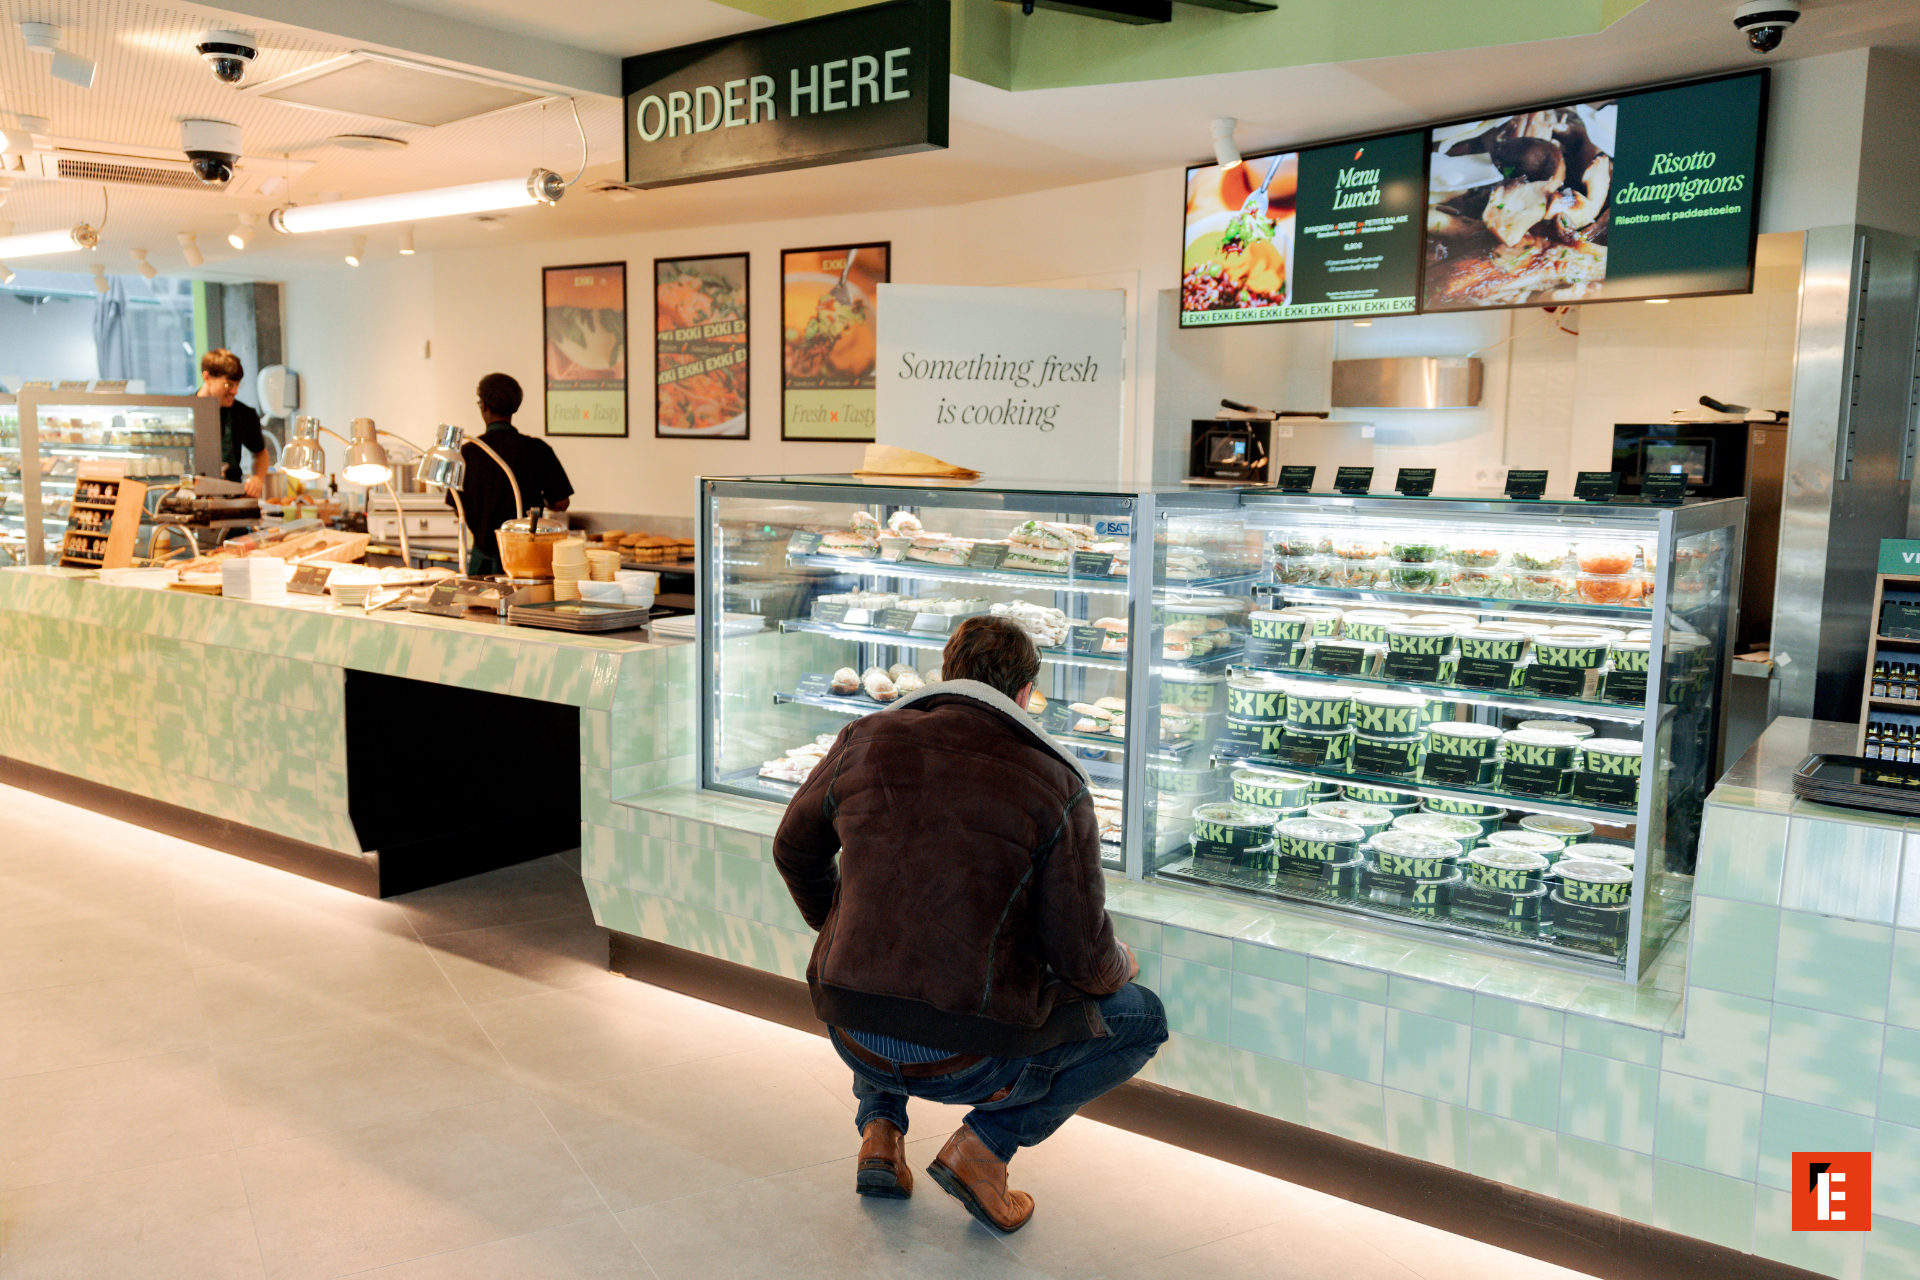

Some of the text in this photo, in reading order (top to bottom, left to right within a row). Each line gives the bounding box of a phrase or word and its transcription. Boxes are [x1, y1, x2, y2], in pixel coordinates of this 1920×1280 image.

[637, 47, 911, 142] ORDER HERE
[1649, 150, 1716, 176] Risotto
[1335, 166, 1380, 189] Menu
[1615, 175, 1745, 204] champignons
[1332, 184, 1381, 210] Lunch
[1615, 204, 1742, 226] Risotto met paddestoelen
[1189, 313, 1210, 323] EXKi
[1212, 311, 1233, 321] EXKi
[1235, 309, 1257, 320] EXKi
[1260, 307, 1282, 318] EXKi
[1284, 306, 1307, 316] EXKi
[1310, 305, 1334, 315] EXKi
[1337, 303, 1362, 313] EXKi
[1364, 301, 1390, 312] EXKi
[1393, 299, 1416, 310] EXK
[675, 326, 702, 341] EXKi
[703, 321, 732, 338] EXKi
[677, 360, 704, 379] EXKi
[705, 352, 734, 371] EXKi
[899, 352, 1098, 388] Something fresh
[552, 404, 581, 421] Fresh
[593, 404, 621, 425] Tasty
[792, 404, 827, 422] Fresh
[843, 404, 875, 427] Tasty
[937, 398, 1060, 432] is cooking
[1107, 522, 1123, 533] ISA
[1252, 619, 1300, 640] EXKi
[1389, 633, 1444, 654] EXKi
[1462, 638, 1518, 660] EXKi
[1537, 645, 1597, 667] EXKi
[1228, 687, 1287, 716] EXKi
[1286, 695, 1350, 725] EXKi
[1356, 702, 1418, 732] EXKi
[1431, 733, 1487, 757] EXKi
[1588, 751, 1641, 776] EXK
[1233, 781, 1283, 807] EXKi
[1280, 836, 1336, 861] EXKi
[1379, 853, 1443, 878] EXKi
[1472, 862, 1528, 890] EXKi
[1563, 878, 1628, 904] EXKi
